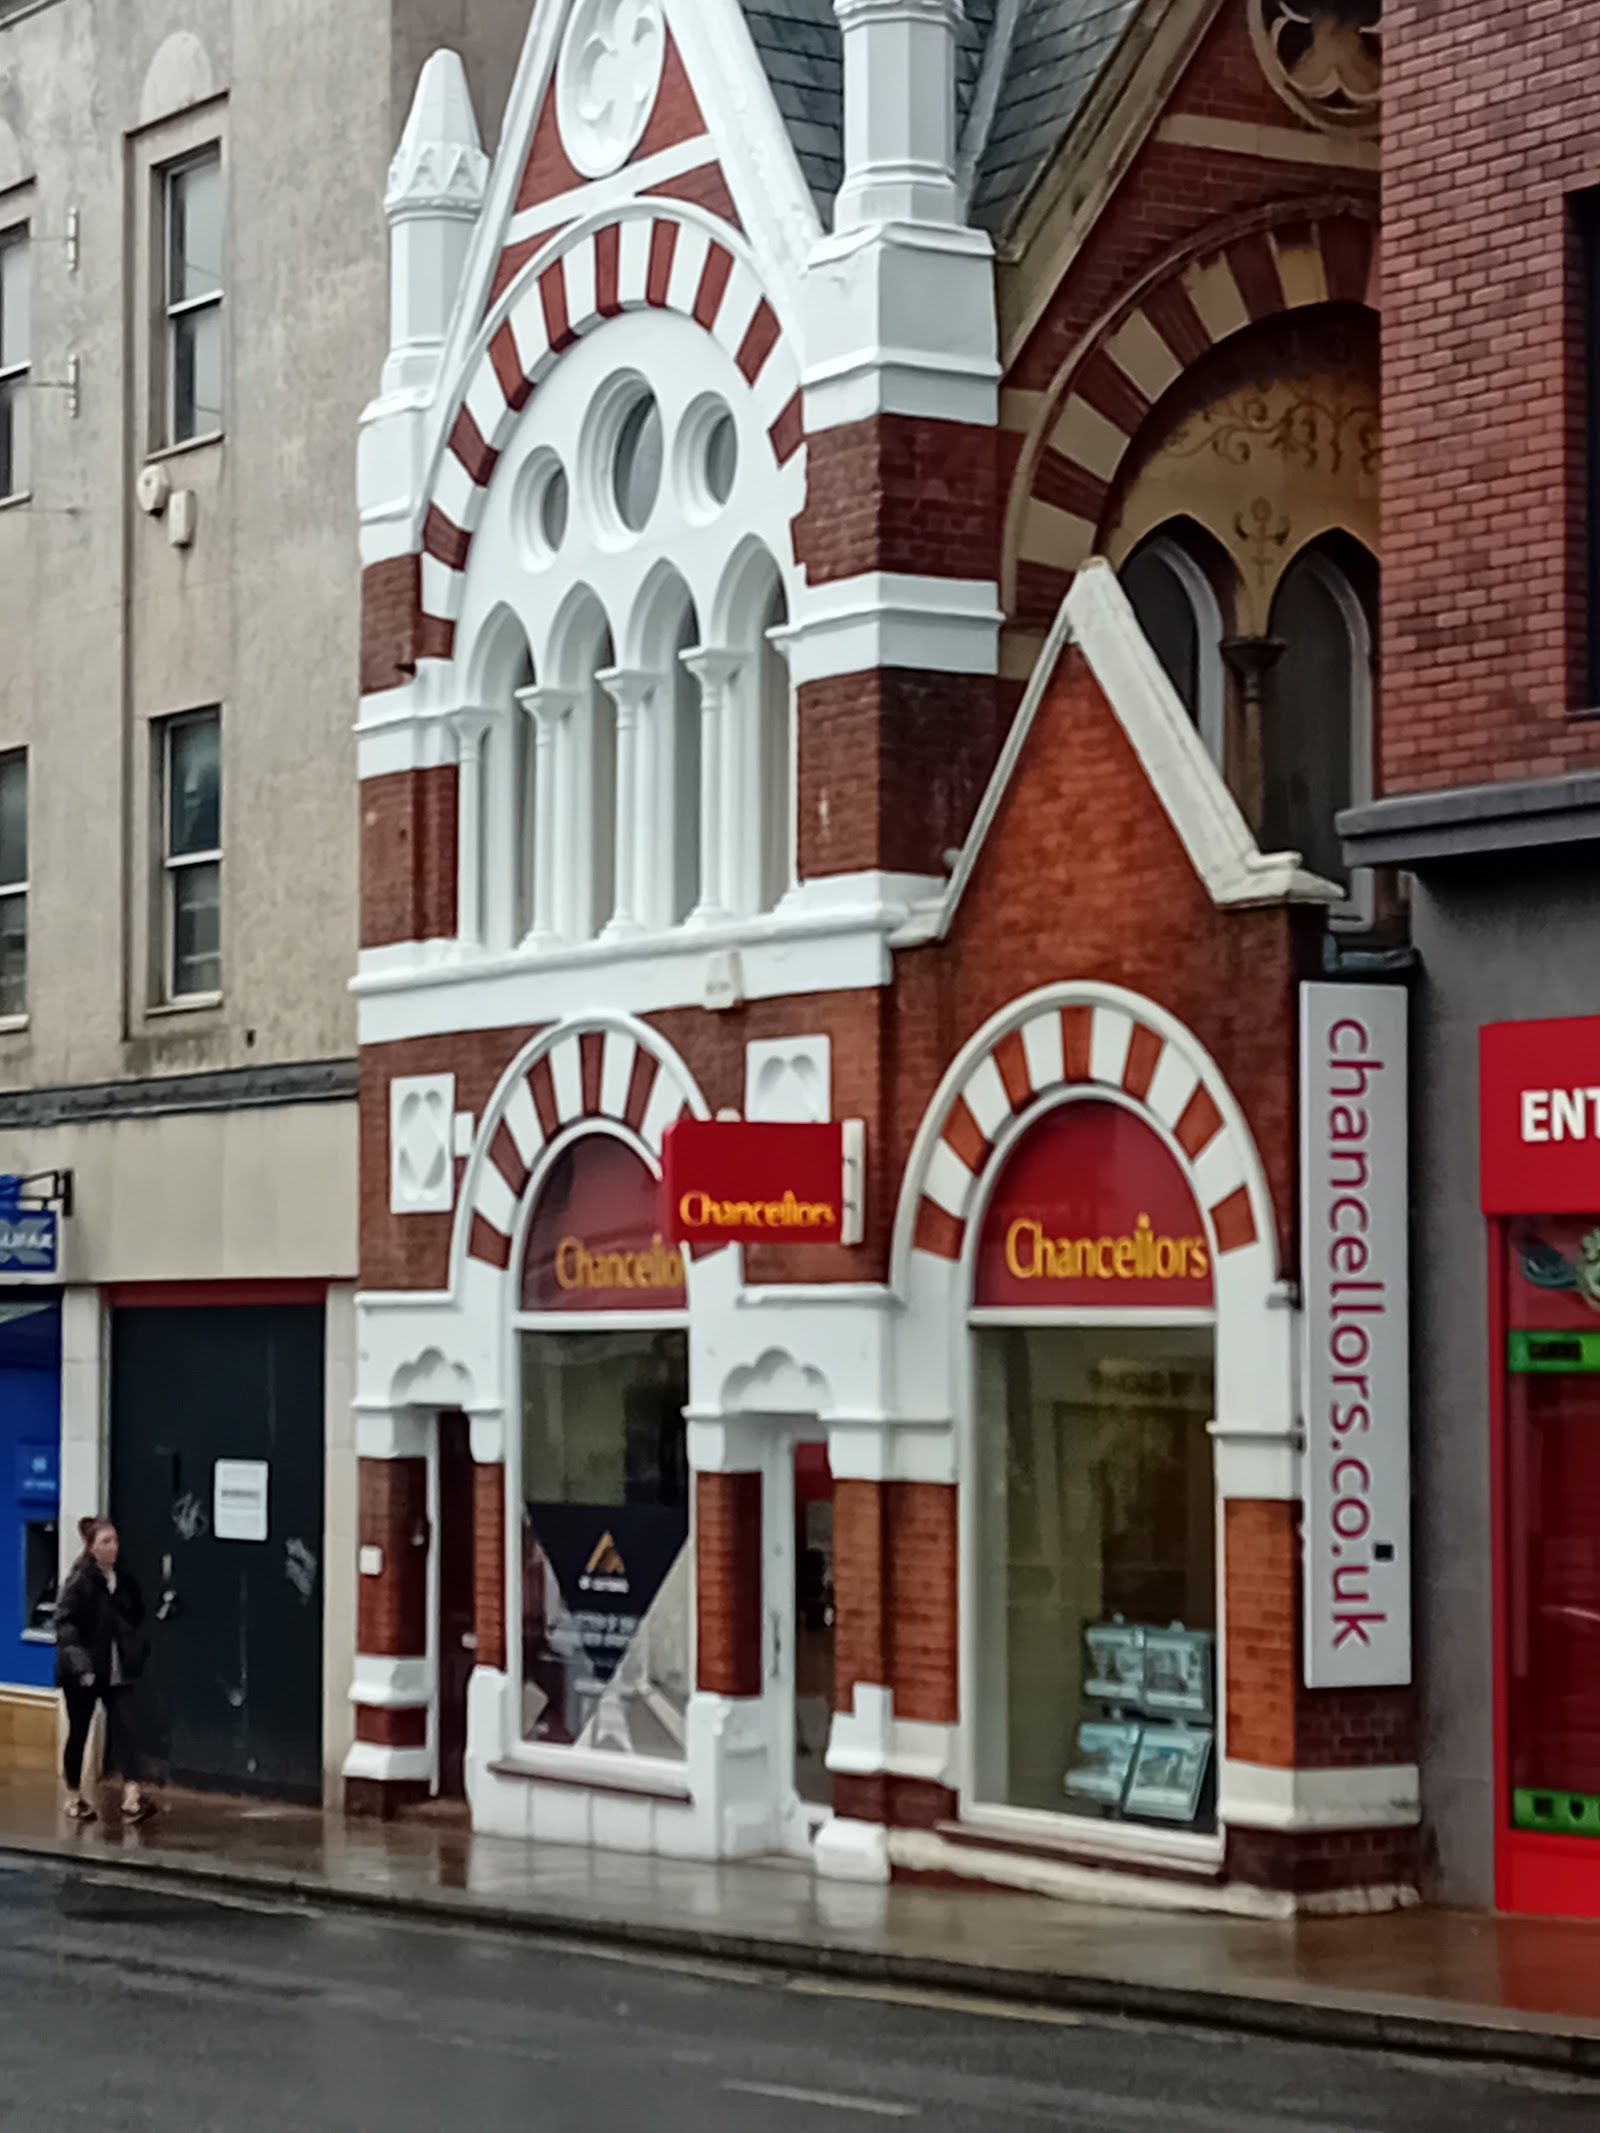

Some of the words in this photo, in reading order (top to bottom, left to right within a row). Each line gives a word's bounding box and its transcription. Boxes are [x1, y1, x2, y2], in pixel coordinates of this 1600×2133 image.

[679, 1189, 836, 1227] Chancellors
[1005, 1211, 1208, 1279] Chancellors
[1328, 1018, 1387, 1650] chancellors.co.uk
